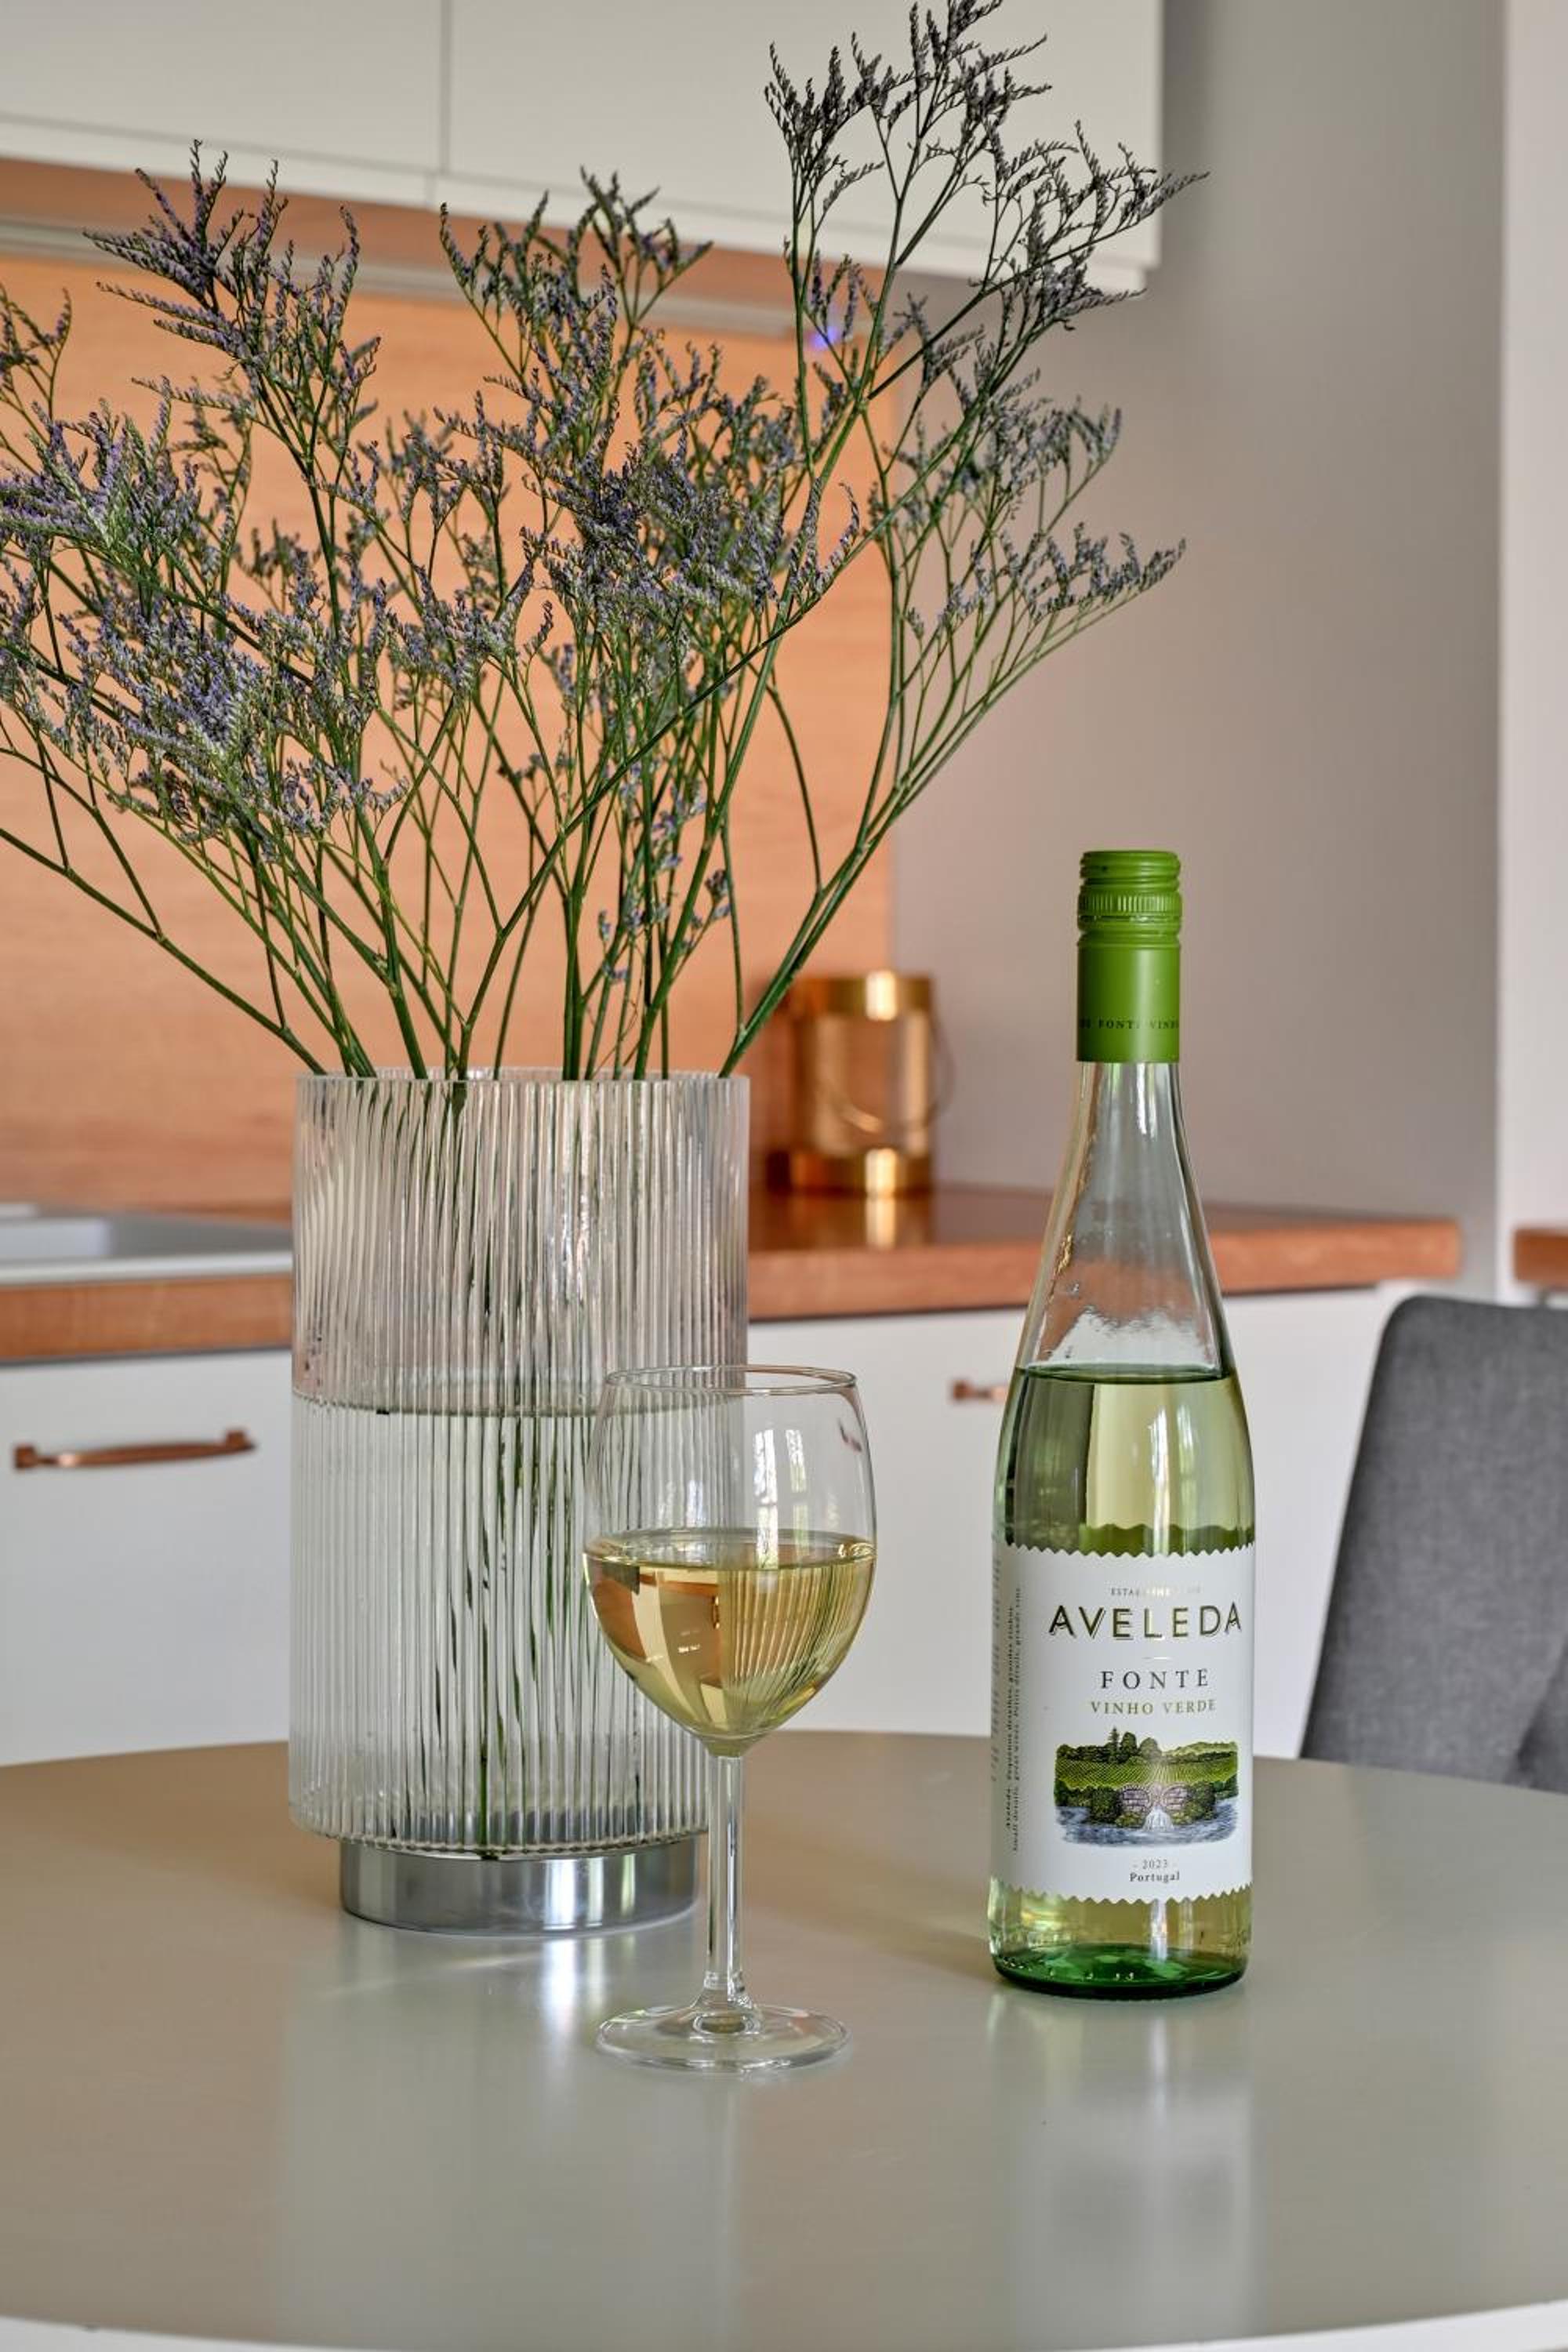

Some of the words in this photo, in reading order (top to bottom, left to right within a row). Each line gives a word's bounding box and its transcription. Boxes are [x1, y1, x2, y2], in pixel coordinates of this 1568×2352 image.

[1048, 1602, 1243, 1640] AVELEDA
[1101, 1669, 1208, 1690] FONTE
[1091, 1701, 1154, 1715] VINHO
[1163, 1699, 1216, 1714] VERDE
[1142, 1859, 1168, 1870] 2023
[1130, 1871, 1180, 1883] Portugal
